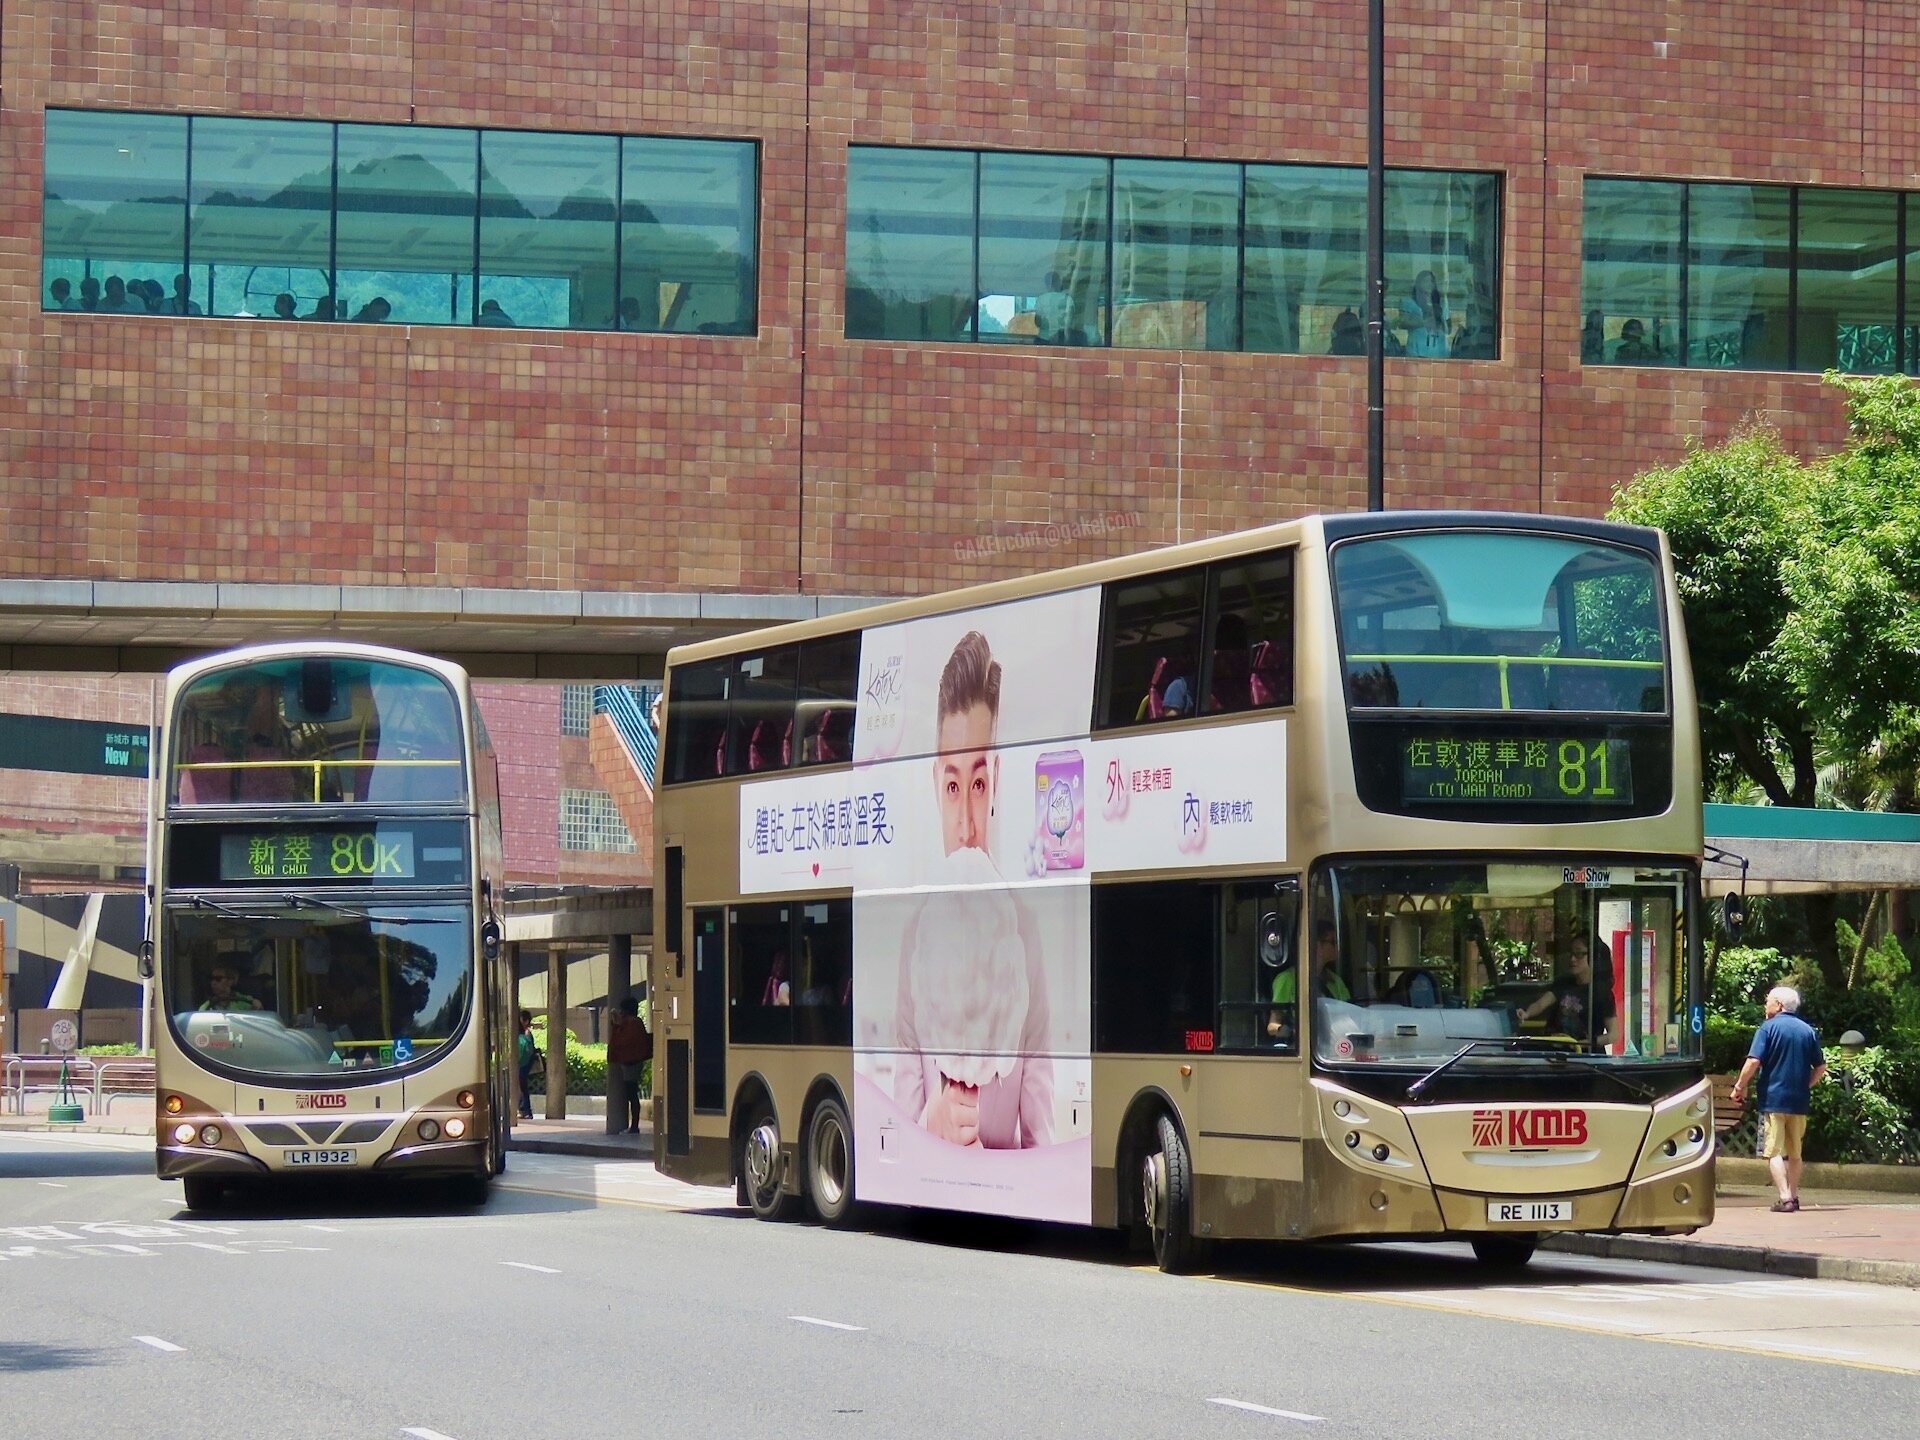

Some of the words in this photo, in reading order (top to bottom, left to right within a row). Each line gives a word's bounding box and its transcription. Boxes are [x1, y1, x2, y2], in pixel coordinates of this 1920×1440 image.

[866, 663, 902, 710] Kotex
[105, 746, 129, 766] New
[1407, 738, 1548, 769] 佐敦渡華路
[1454, 769, 1503, 783] JORDAN
[1558, 739, 1615, 796] 81
[1106, 758, 1125, 803] 外
[1132, 768, 1173, 793] 輕柔棉面
[1460, 784, 1487, 797] WAH
[1492, 783, 1532, 797] ROAD)
[1209, 799, 1253, 825] 鬆軟棉枕
[249, 835, 313, 865] 新翠
[330, 833, 402, 874] 80K
[254, 864, 274, 875] SUN
[282, 864, 308, 875] CHUI
[1563, 868, 1610, 883] RoadShow
[1193, 1031, 1214, 1051] KMB
[1340, 1042, 1349, 1053] S
[310, 1094, 347, 1109] KMB
[1508, 1109, 1588, 1146] KMB
[292, 1152, 311, 1163] LR
[316, 1151, 349, 1163] 1932
[1501, 1205, 1522, 1220] RE
[1532, 1204, 1559, 1219] 1113
